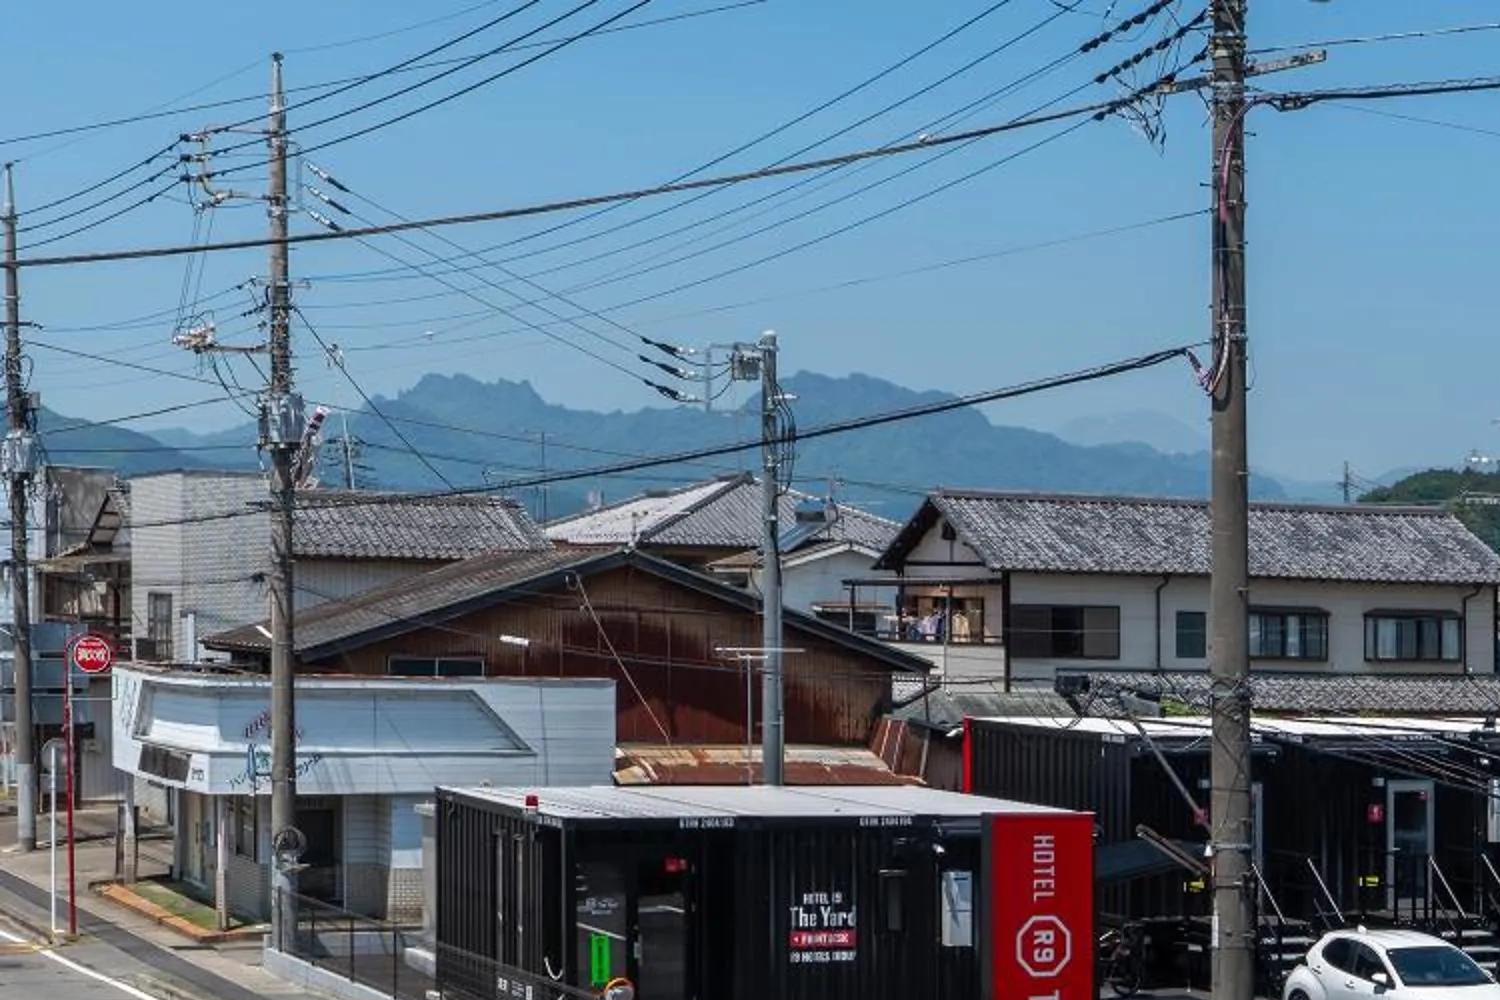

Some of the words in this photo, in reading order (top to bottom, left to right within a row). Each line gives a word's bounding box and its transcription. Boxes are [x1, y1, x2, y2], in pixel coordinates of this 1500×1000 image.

[1033, 835, 1055, 902] HOTEL
[790, 906, 817, 927] The
[820, 905, 857, 927] Yard
[1033, 929, 1055, 962] R9
